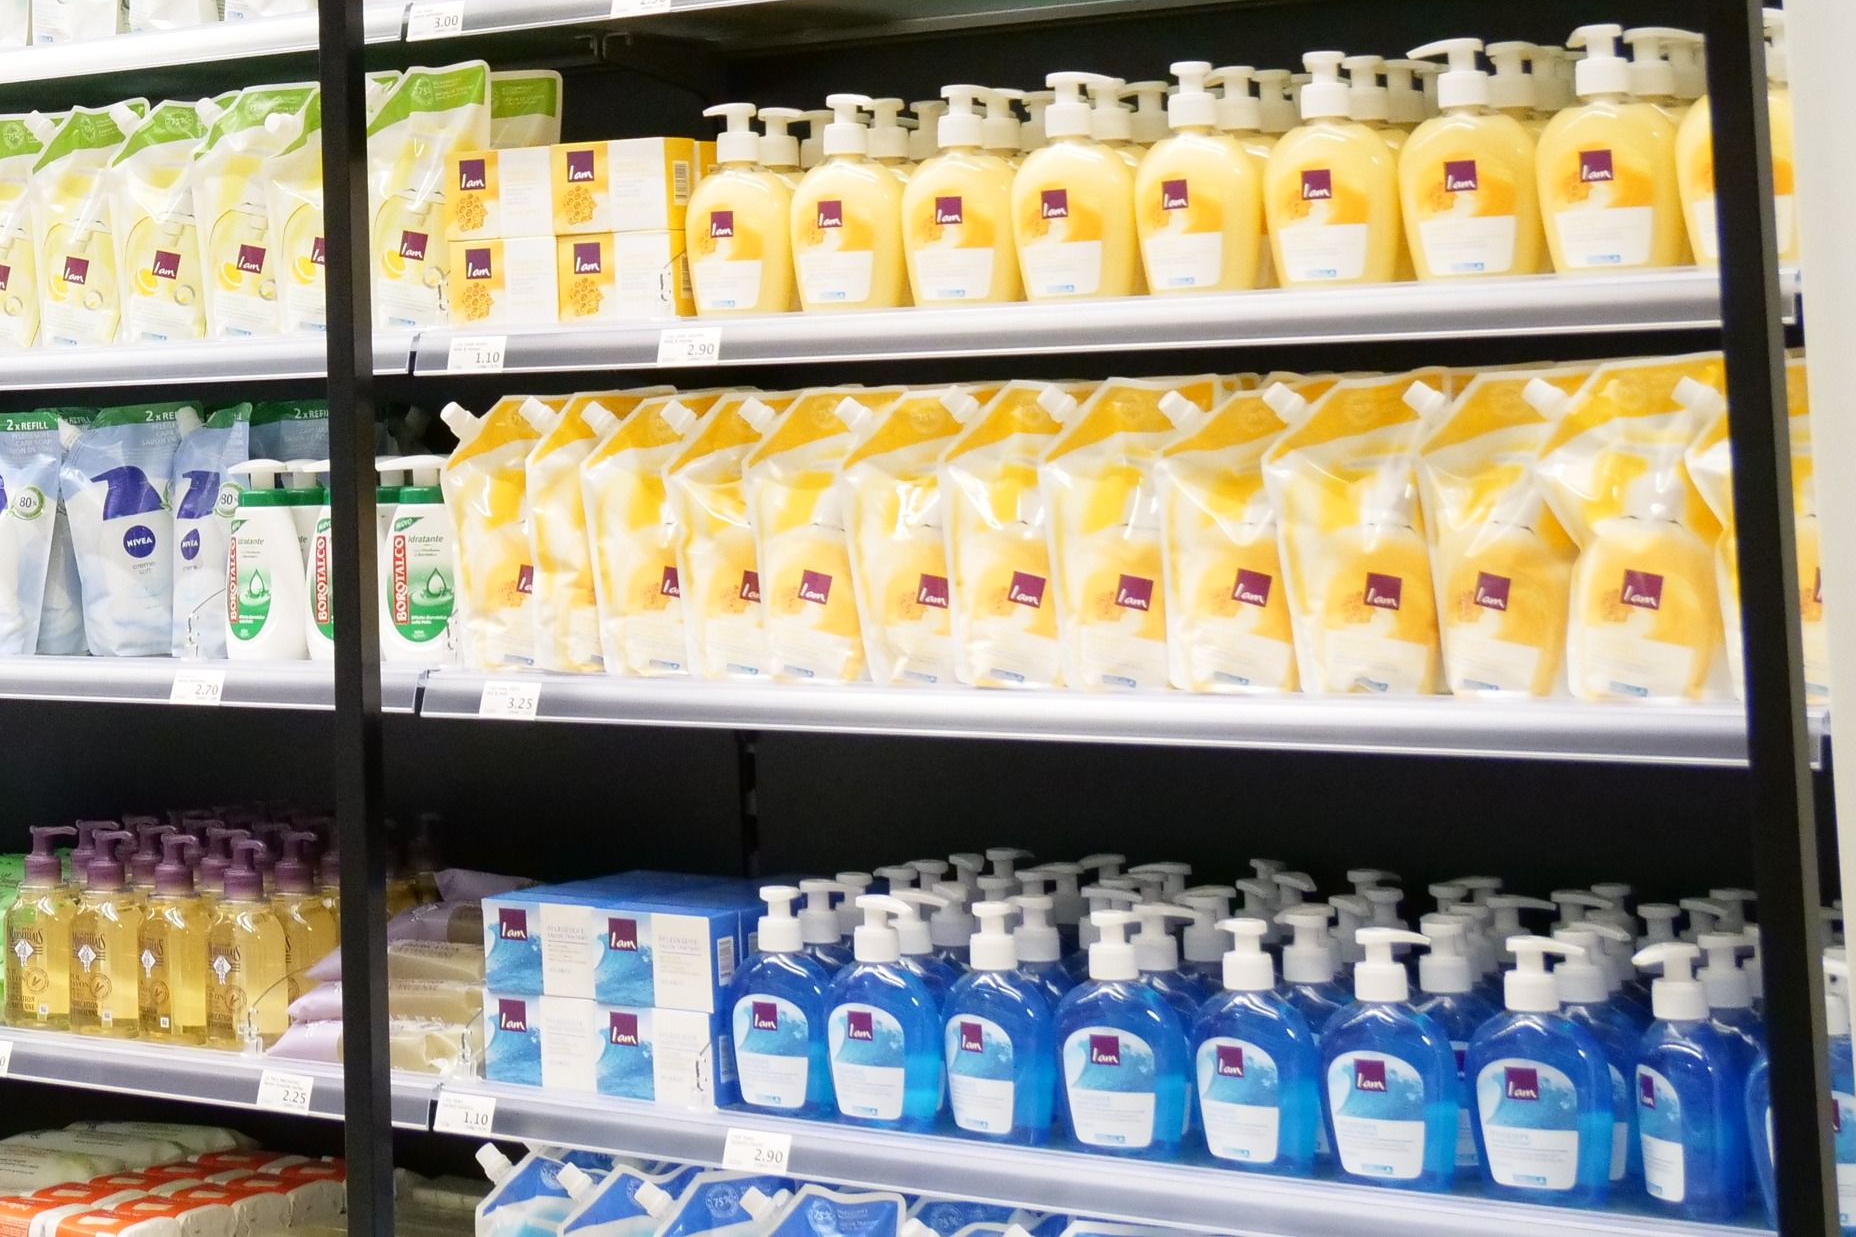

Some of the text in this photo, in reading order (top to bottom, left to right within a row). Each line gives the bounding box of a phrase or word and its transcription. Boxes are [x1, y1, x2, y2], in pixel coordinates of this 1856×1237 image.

[434, 15, 459, 28] 3.00
[688, 343, 714, 356] 2.90
[476, 351, 500, 364] 1.10
[126, 537, 153, 548] NIVEA
[316, 537, 328, 622] BOROTALCO
[394, 536, 408, 623] BOROTALCO
[195, 684, 219, 696] 2.70
[507, 697, 533, 710] 3.25
[282, 1091, 307, 1104] 2.25
[463, 1112, 489, 1125] 1.10
[754, 1150, 784, 1163] 2.90
